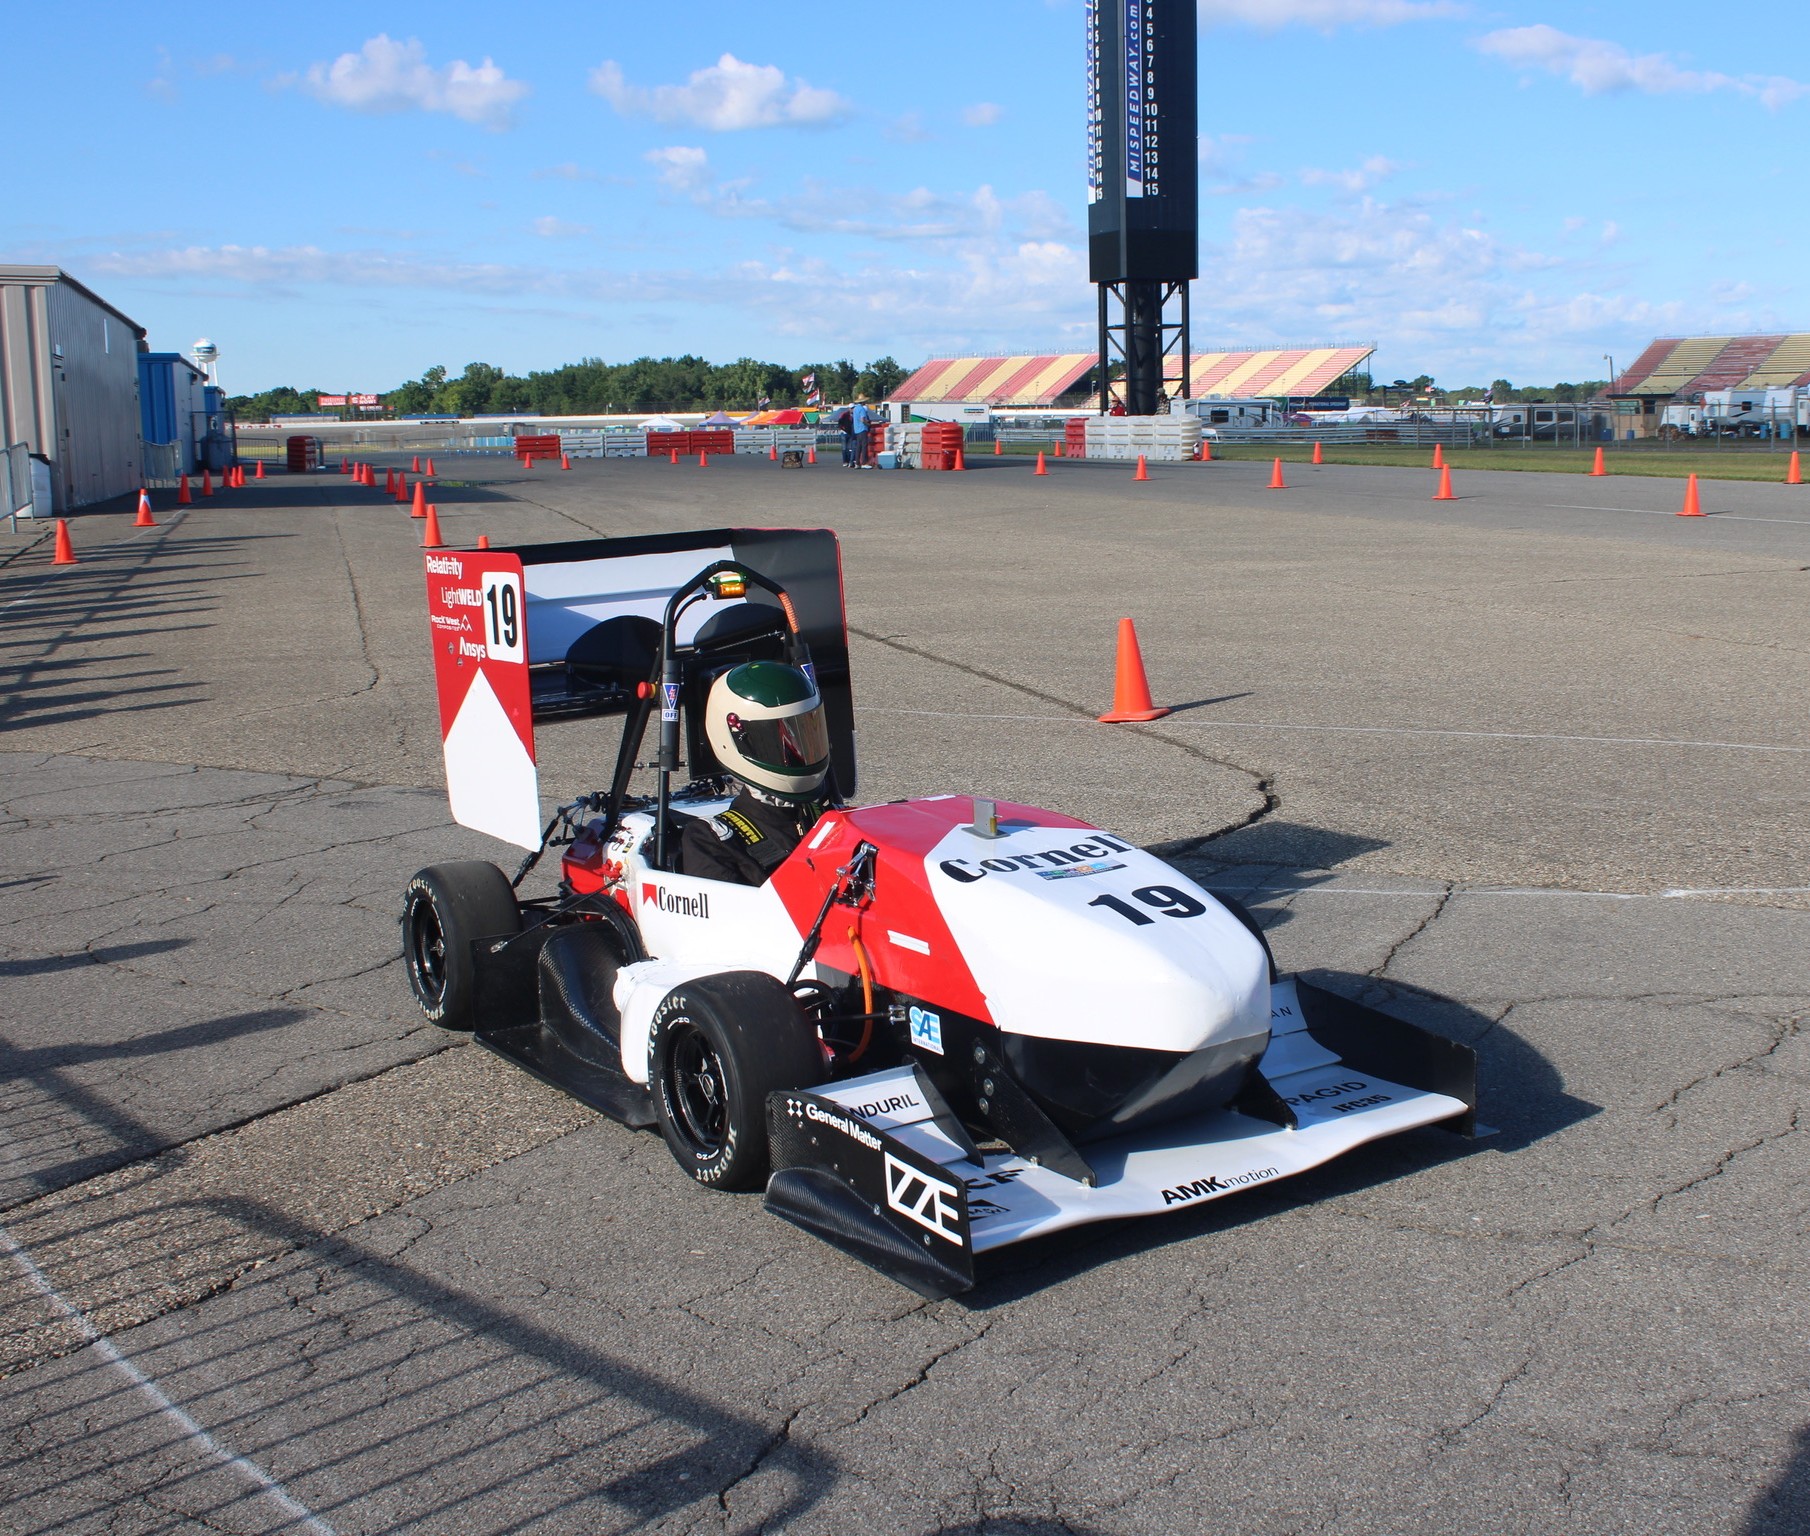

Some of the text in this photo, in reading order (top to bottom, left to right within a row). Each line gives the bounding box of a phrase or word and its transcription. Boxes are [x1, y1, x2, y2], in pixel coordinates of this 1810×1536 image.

[1146, 7, 1153, 19] 4
[1094, 14, 1099, 26] 4
[1146, 23, 1153, 35] 5
[1094, 30, 1100, 43] 5
[1146, 39, 1154, 52] 6
[1095, 46, 1100, 59] 6
[1146, 55, 1154, 67] 7
[1095, 62, 1100, 74] 7
[1095, 77, 1100, 90] 8
[1146, 71, 1154, 84] 8
[1129, 5, 1140, 172] MISPEEDWAY.com
[1147, 87, 1155, 100] 9
[1095, 93, 1101, 106] 9
[1095, 109, 1102, 121] 10
[1144, 103, 1158, 116] 10
[1095, 125, 1102, 137] 11
[1144, 119, 1158, 132] 11
[1095, 140, 1102, 153] 12
[1144, 135, 1158, 148] 12
[1095, 156, 1102, 169] 13
[1144, 151, 1159, 164] 13
[1095, 172, 1103, 184] 14
[1145, 167, 1159, 180] 14
[1095, 187, 1103, 200] 15
[1145, 183, 1159, 196] 15
[426, 555, 463, 580] Relativity
[441, 586, 482, 609] LightWELD
[486, 584, 518, 649] 19
[459, 636, 486, 662] Ansys
[658, 885, 710, 919] Cornell
[1087, 885, 1207, 926] 19
[910, 1007, 941, 1045] SAE
[1281, 1081, 1367, 1107] PAGID
[849, 1094, 920, 1119] NDURIL
[805, 1103, 883, 1152] General Matter
